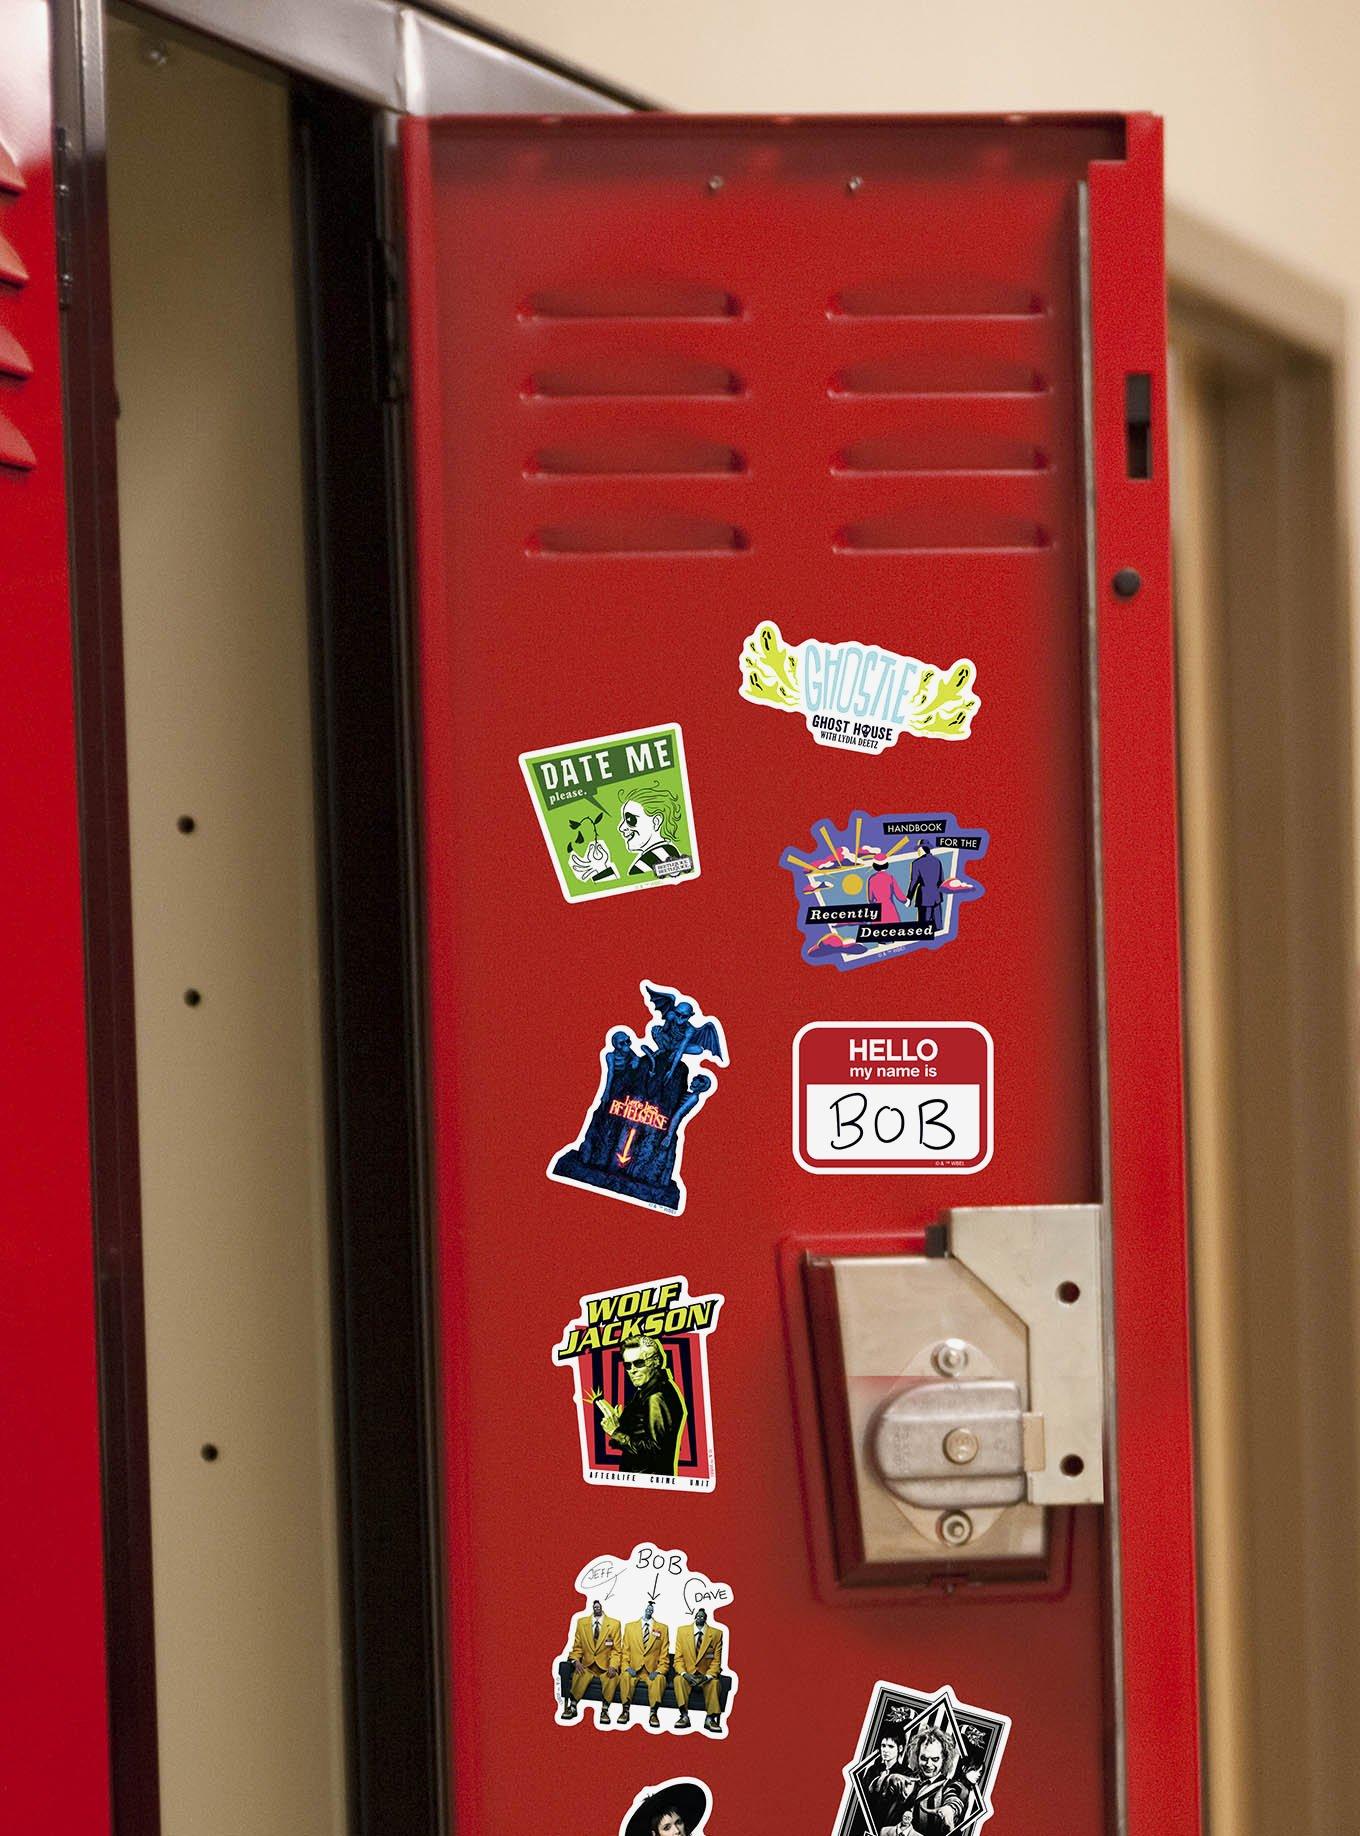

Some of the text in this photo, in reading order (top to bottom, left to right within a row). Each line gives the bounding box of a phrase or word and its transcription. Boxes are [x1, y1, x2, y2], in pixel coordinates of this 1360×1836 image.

[803, 644, 917, 724] GHOSTIE
[812, 715, 850, 733] GHOST
[820, 731, 879, 749] WITH LYDIA DEETZ
[540, 739, 671, 790] DATE ME
[549, 788, 588, 805] please.
[887, 823, 942, 833] HANDBOOK
[939, 838, 977, 848] FOR THE
[809, 908, 879, 920] Recently
[860, 925, 934, 938] Deceased
[849, 1038, 939, 1062] HELLO
[850, 1064, 937, 1080] my name is
[829, 1092, 956, 1150] BOB
[586, 1282, 682, 1325] WOLF
[558, 1300, 718, 1360] JACKSON
[589, 1471, 710, 1487] AFTERLIFE CRIME UNIT
[636, 1548, 683, 1575] BOB
[588, 1566, 615, 1580] JEFF
[694, 1589, 728, 1603] DAVE
